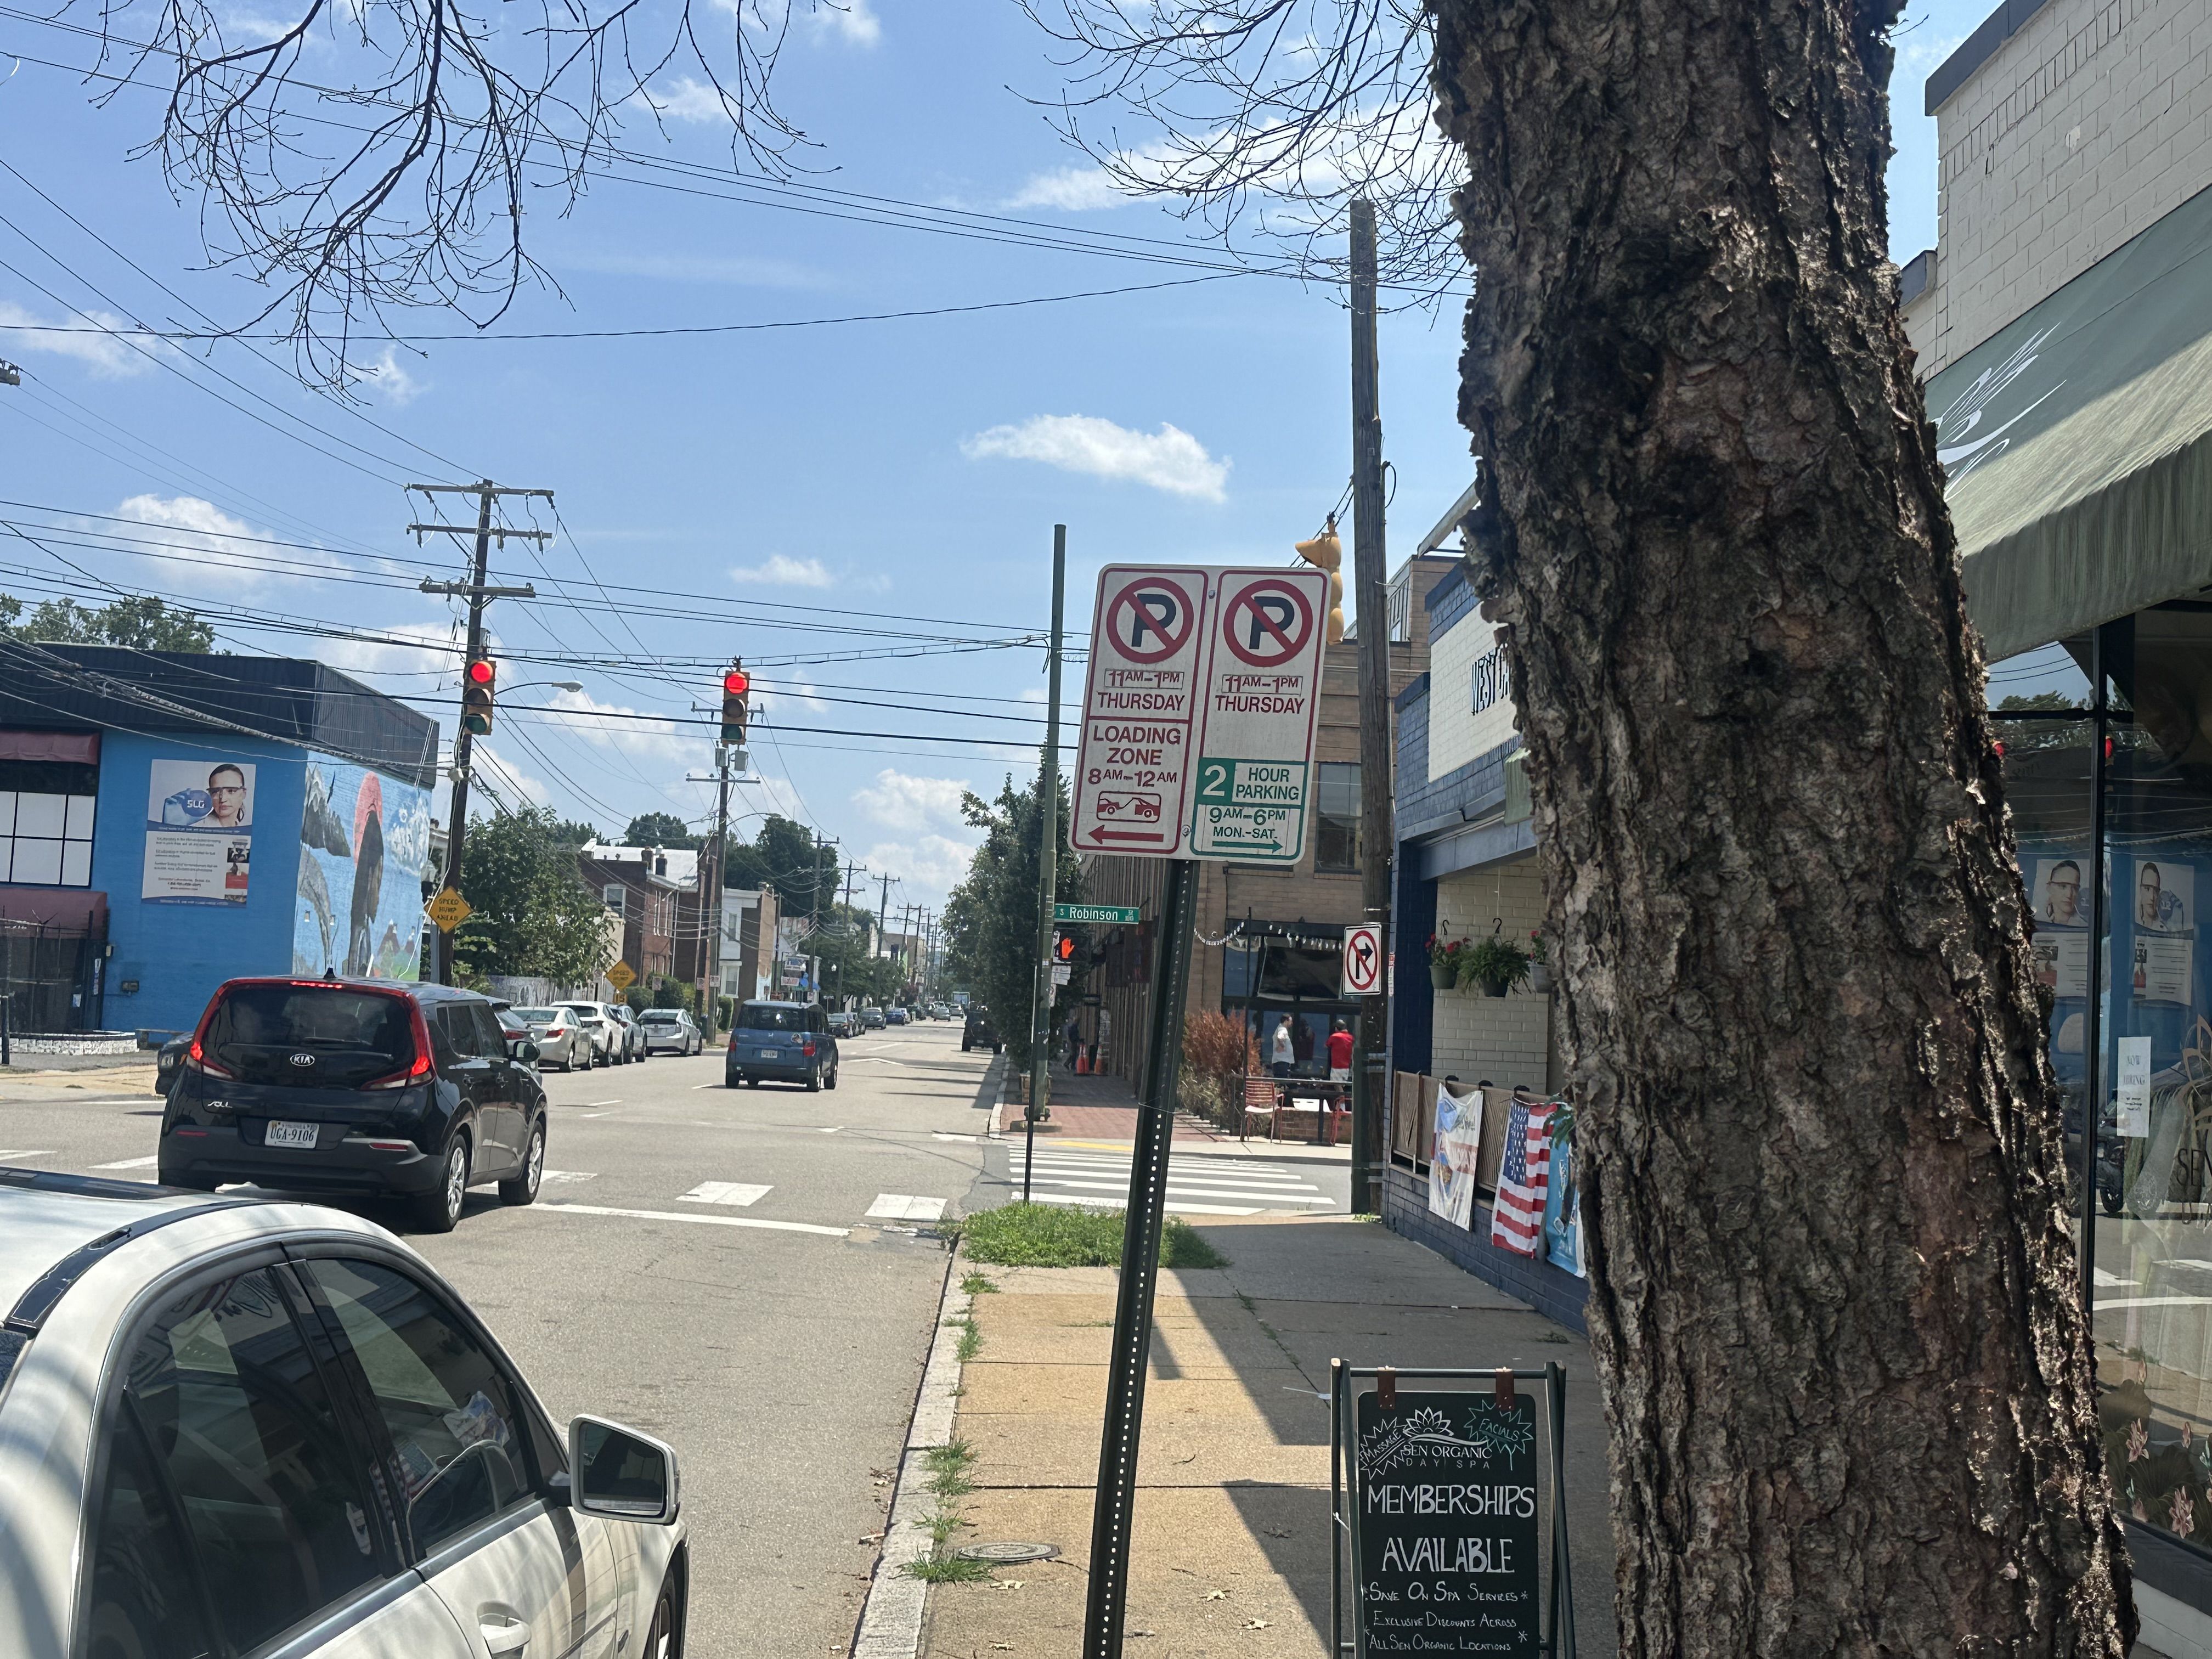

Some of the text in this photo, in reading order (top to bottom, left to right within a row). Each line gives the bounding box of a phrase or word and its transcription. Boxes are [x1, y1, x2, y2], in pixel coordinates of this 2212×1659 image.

[1098, 692, 1185, 711] THURSDAY
[1215, 695, 1305, 714] THURSDAY
[1093, 725, 1181, 745] LOADING
[1107, 747, 1163, 765] ZONE
[1203, 765, 1226, 796] 2
[1248, 768, 1290, 782] HOUR
[1235, 784, 1299, 800] PARKING
[1069, 906, 1118, 921] Robinson
[294, 1055, 311, 1064] KIA
[1479, 1419, 1520, 1441] FACIALS
[1363, 1429, 1402, 1463] MASSAGE
[1403, 1445, 1493, 1459] SEN ORGANIC
[1406, 1458, 1490, 1469] DAY SPA
[1368, 1484, 1535, 1519] MEMBERSHIPS
[1381, 1537, 1515, 1573] AVAILABLE
[1370, 1582, 1400, 1601] SAVE
[1408, 1582, 1429, 1600] ON
[1434, 1581, 1460, 1601] SPA
[1479, 1613, 1517, 1628] ACROSS
[1369, 1633, 1511, 1651] ALL SEN ORGANIC LOCATIONS
